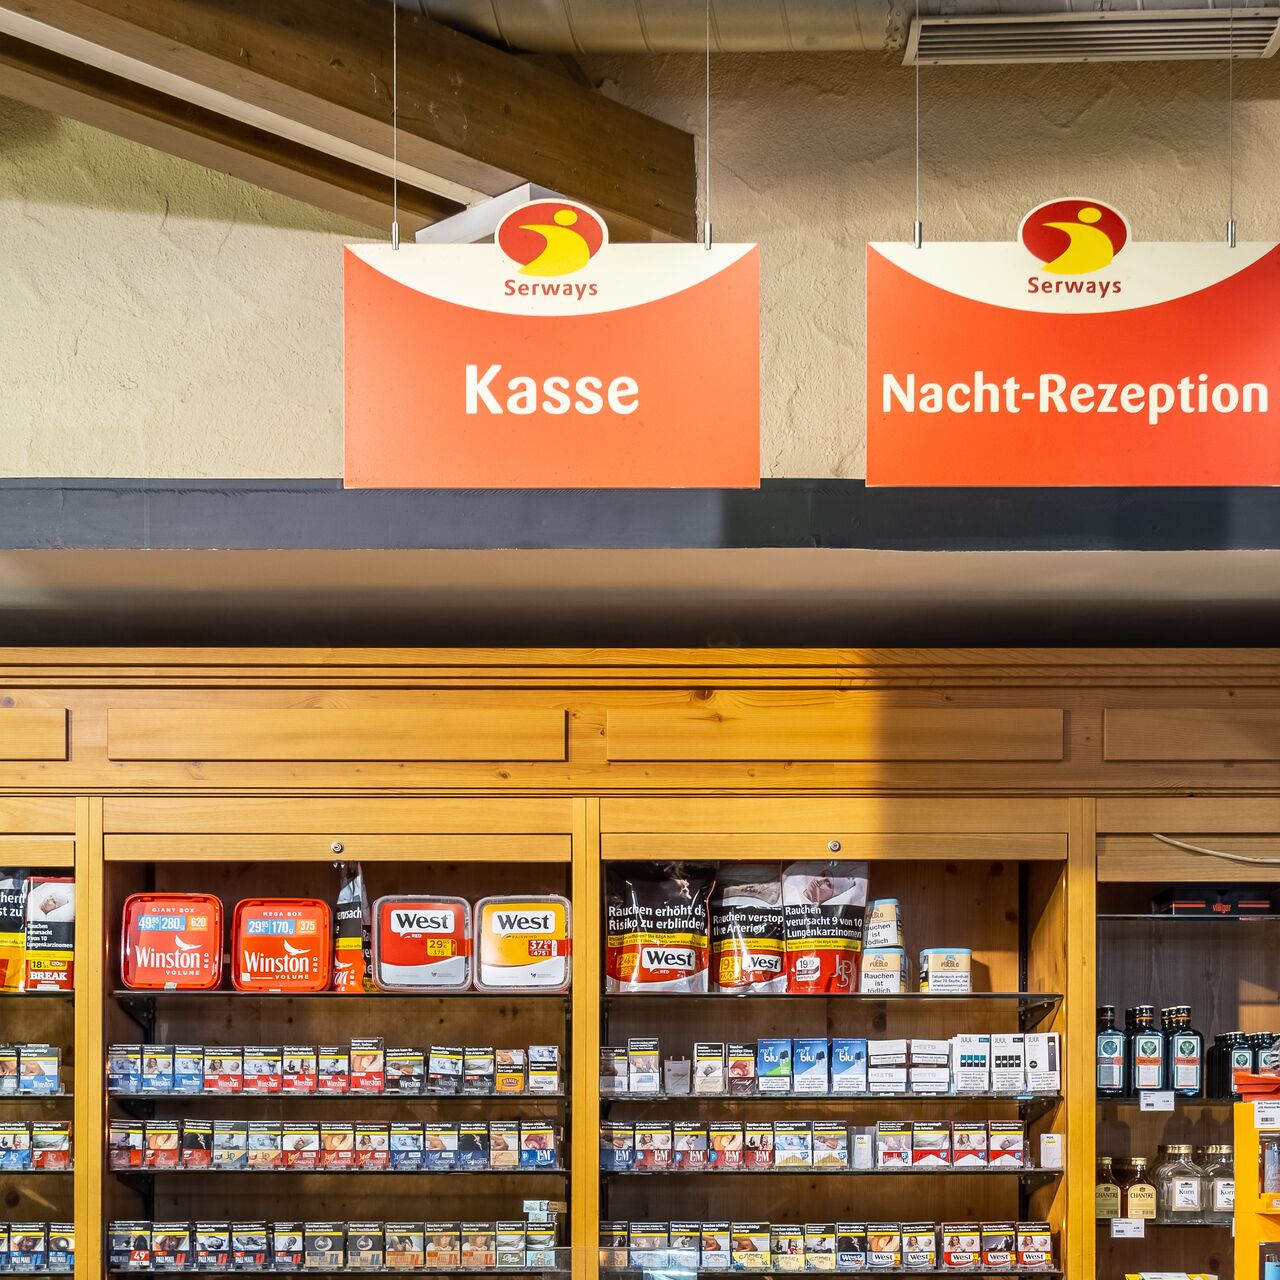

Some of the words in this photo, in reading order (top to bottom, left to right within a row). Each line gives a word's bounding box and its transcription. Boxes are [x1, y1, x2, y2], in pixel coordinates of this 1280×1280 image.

[504, 278, 599, 301] Serways
[1027, 275, 1123, 299] Serways
[465, 365, 640, 414] Kasse
[882, 372, 1269, 425] Nacht-Rezeption
[10, 906, 23, 916] zu
[608, 905, 652, 918] Rauchen
[655, 905, 692, 918] erhöht
[785, 906, 821, 916] Rauchen
[396, 912, 449, 930] West
[497, 912, 550, 931] West
[609, 918, 638, 931] Risiko
[641, 920, 655, 929] zu
[786, 916, 829, 927] verursacht
[831, 916, 838, 925] 9
[839, 918, 852, 926] von
[853, 918, 863, 927] 10
[787, 927, 863, 940] Lungenkarzinomen
[135, 945, 201, 970] Winston
[244, 949, 310, 974] Winston
[646, 950, 695, 968] West
[30, 970, 68, 981] BREAK
[864, 972, 895, 981] Rauchen
[764, 1052, 778, 1062] blu
[1178, 1188, 1195, 1196] Korn
